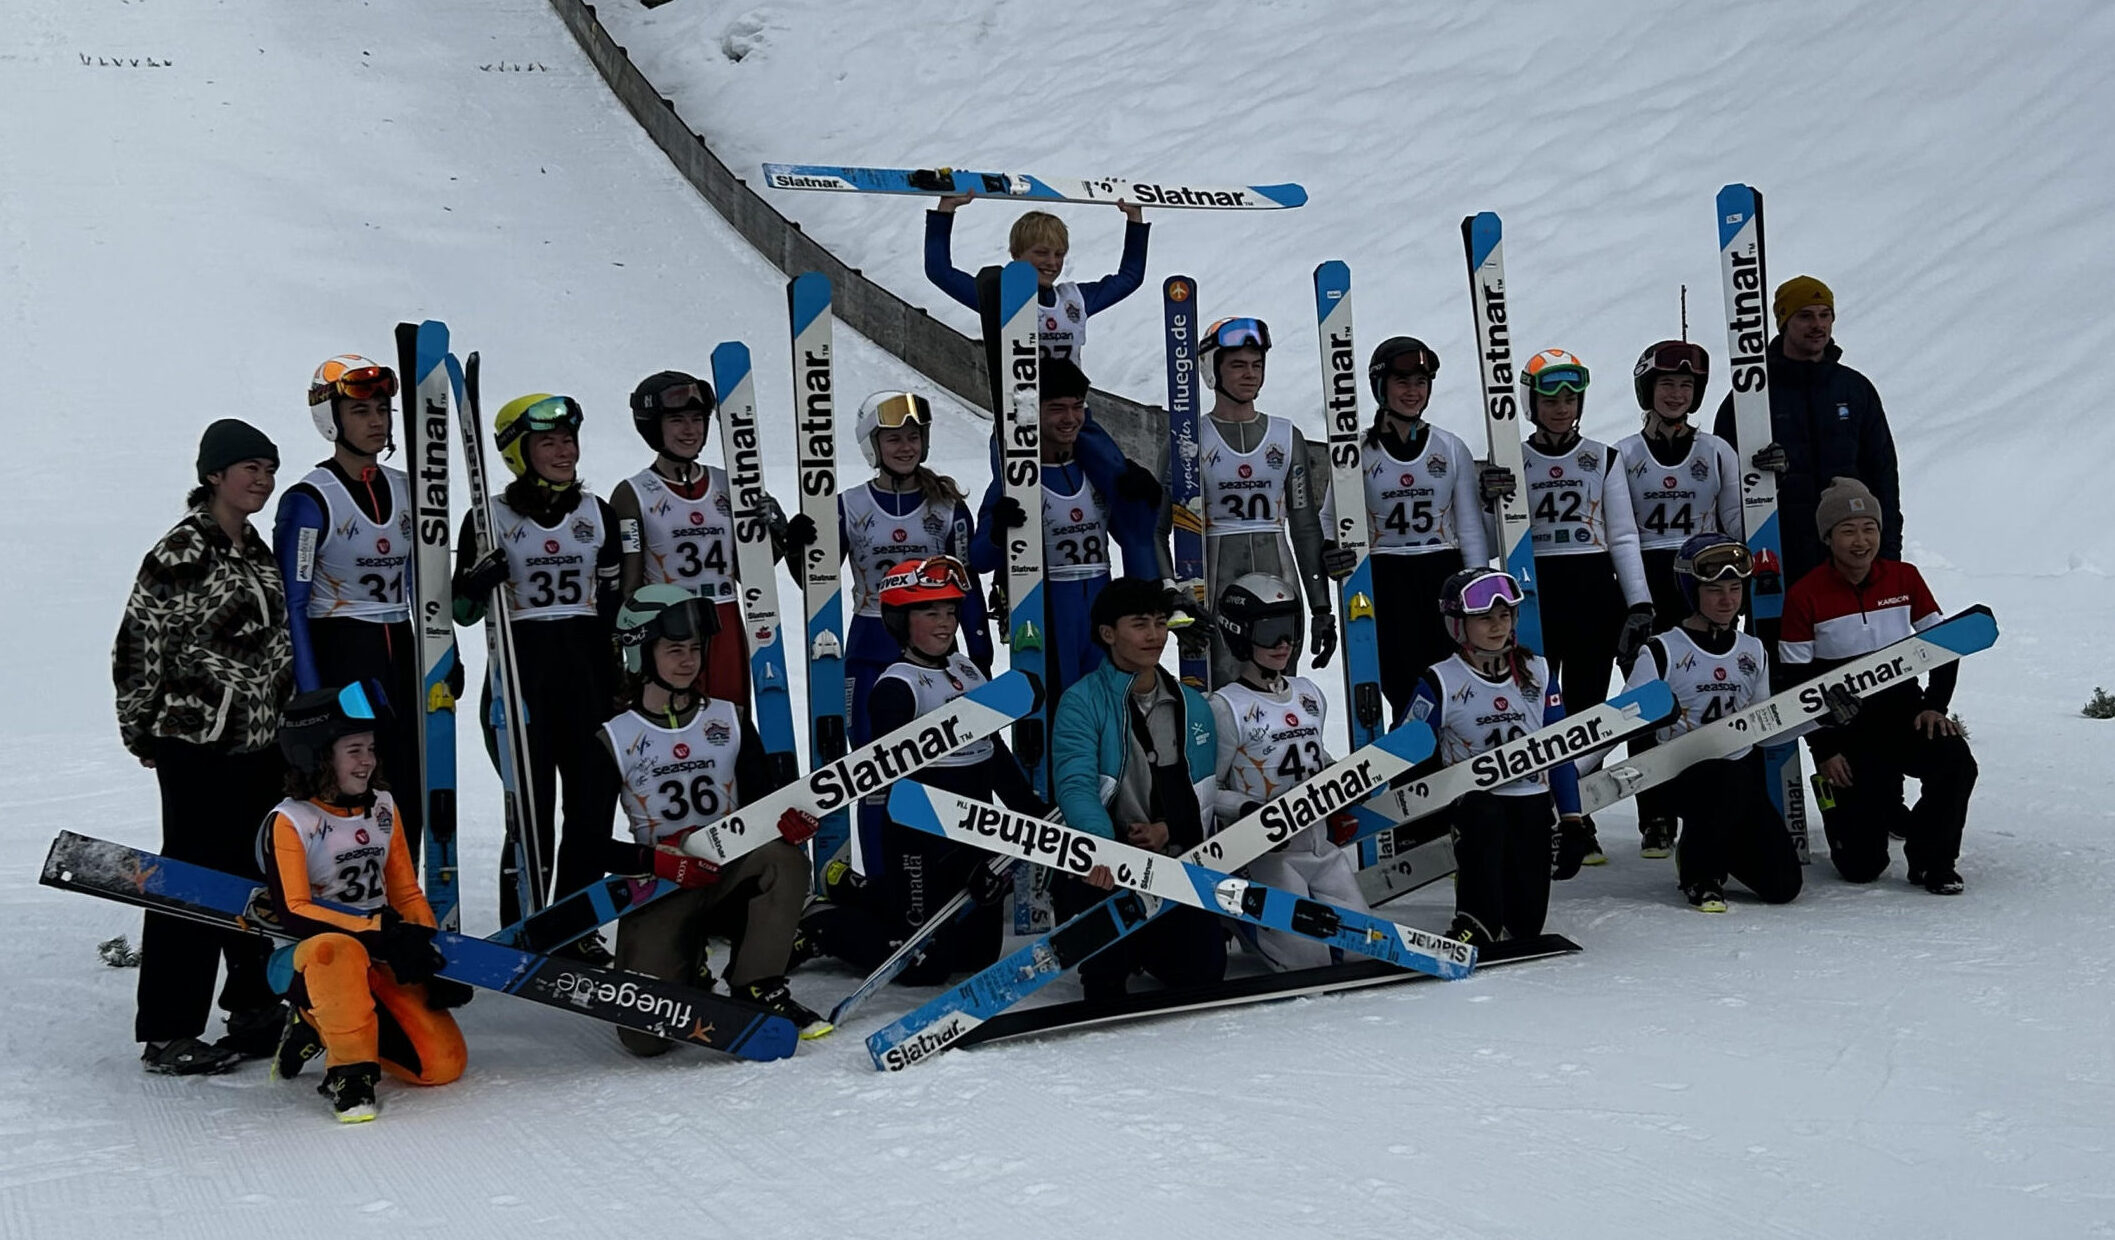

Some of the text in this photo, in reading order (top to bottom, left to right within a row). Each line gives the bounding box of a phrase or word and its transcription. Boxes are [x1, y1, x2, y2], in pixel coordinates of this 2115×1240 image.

[776, 175, 841, 189] Slatnar
[1133, 184, 1245, 206] Slatnar
[1730, 251, 1766, 393] Slatnar
[1173, 314, 1193, 412] fluege.de
[1487, 284, 1516, 420] Slatnar
[1330, 333, 1360, 469] Slatnar
[802, 351, 835, 497] Slatnar
[420, 397, 448, 547] Slatnar
[731, 412, 767, 543] Slatnar
[1219, 479, 1271, 490] seaspan
[1531, 478, 1583, 490] seaspan
[1221, 493, 1271, 520] 30
[1382, 487, 1434, 500] seaspan
[1535, 491, 1583, 523] 42
[1643, 490, 1696, 500] seaspan
[672, 527, 725, 539] seaspan
[1052, 521, 1101, 535] seaspan
[1385, 501, 1434, 535] 45
[1644, 503, 1694, 535] 44
[525, 554, 583, 567] seaspan
[677, 540, 728, 578] 34
[872, 543, 929, 556] seaspan
[1057, 536, 1103, 565] 38
[359, 571, 402, 603] 31
[530, 570, 582, 607] 35
[1799, 656, 1904, 713] Sltnar
[1271, 726, 1319, 742] seaspan
[1475, 711, 1526, 726] seaspan
[652, 758, 716, 777] seaspan
[811, 715, 959, 810] Slatnar
[1278, 740, 1323, 782] 43
[1472, 715, 1602, 787] Slatnar
[658, 775, 719, 821] 36
[1260, 759, 1373, 843] Slatnar
[335, 846, 385, 864] seaspan
[959, 804, 1096, 873] Slatnar
[337, 859, 383, 903] 32
[557, 972, 692, 1029] fluege.de
